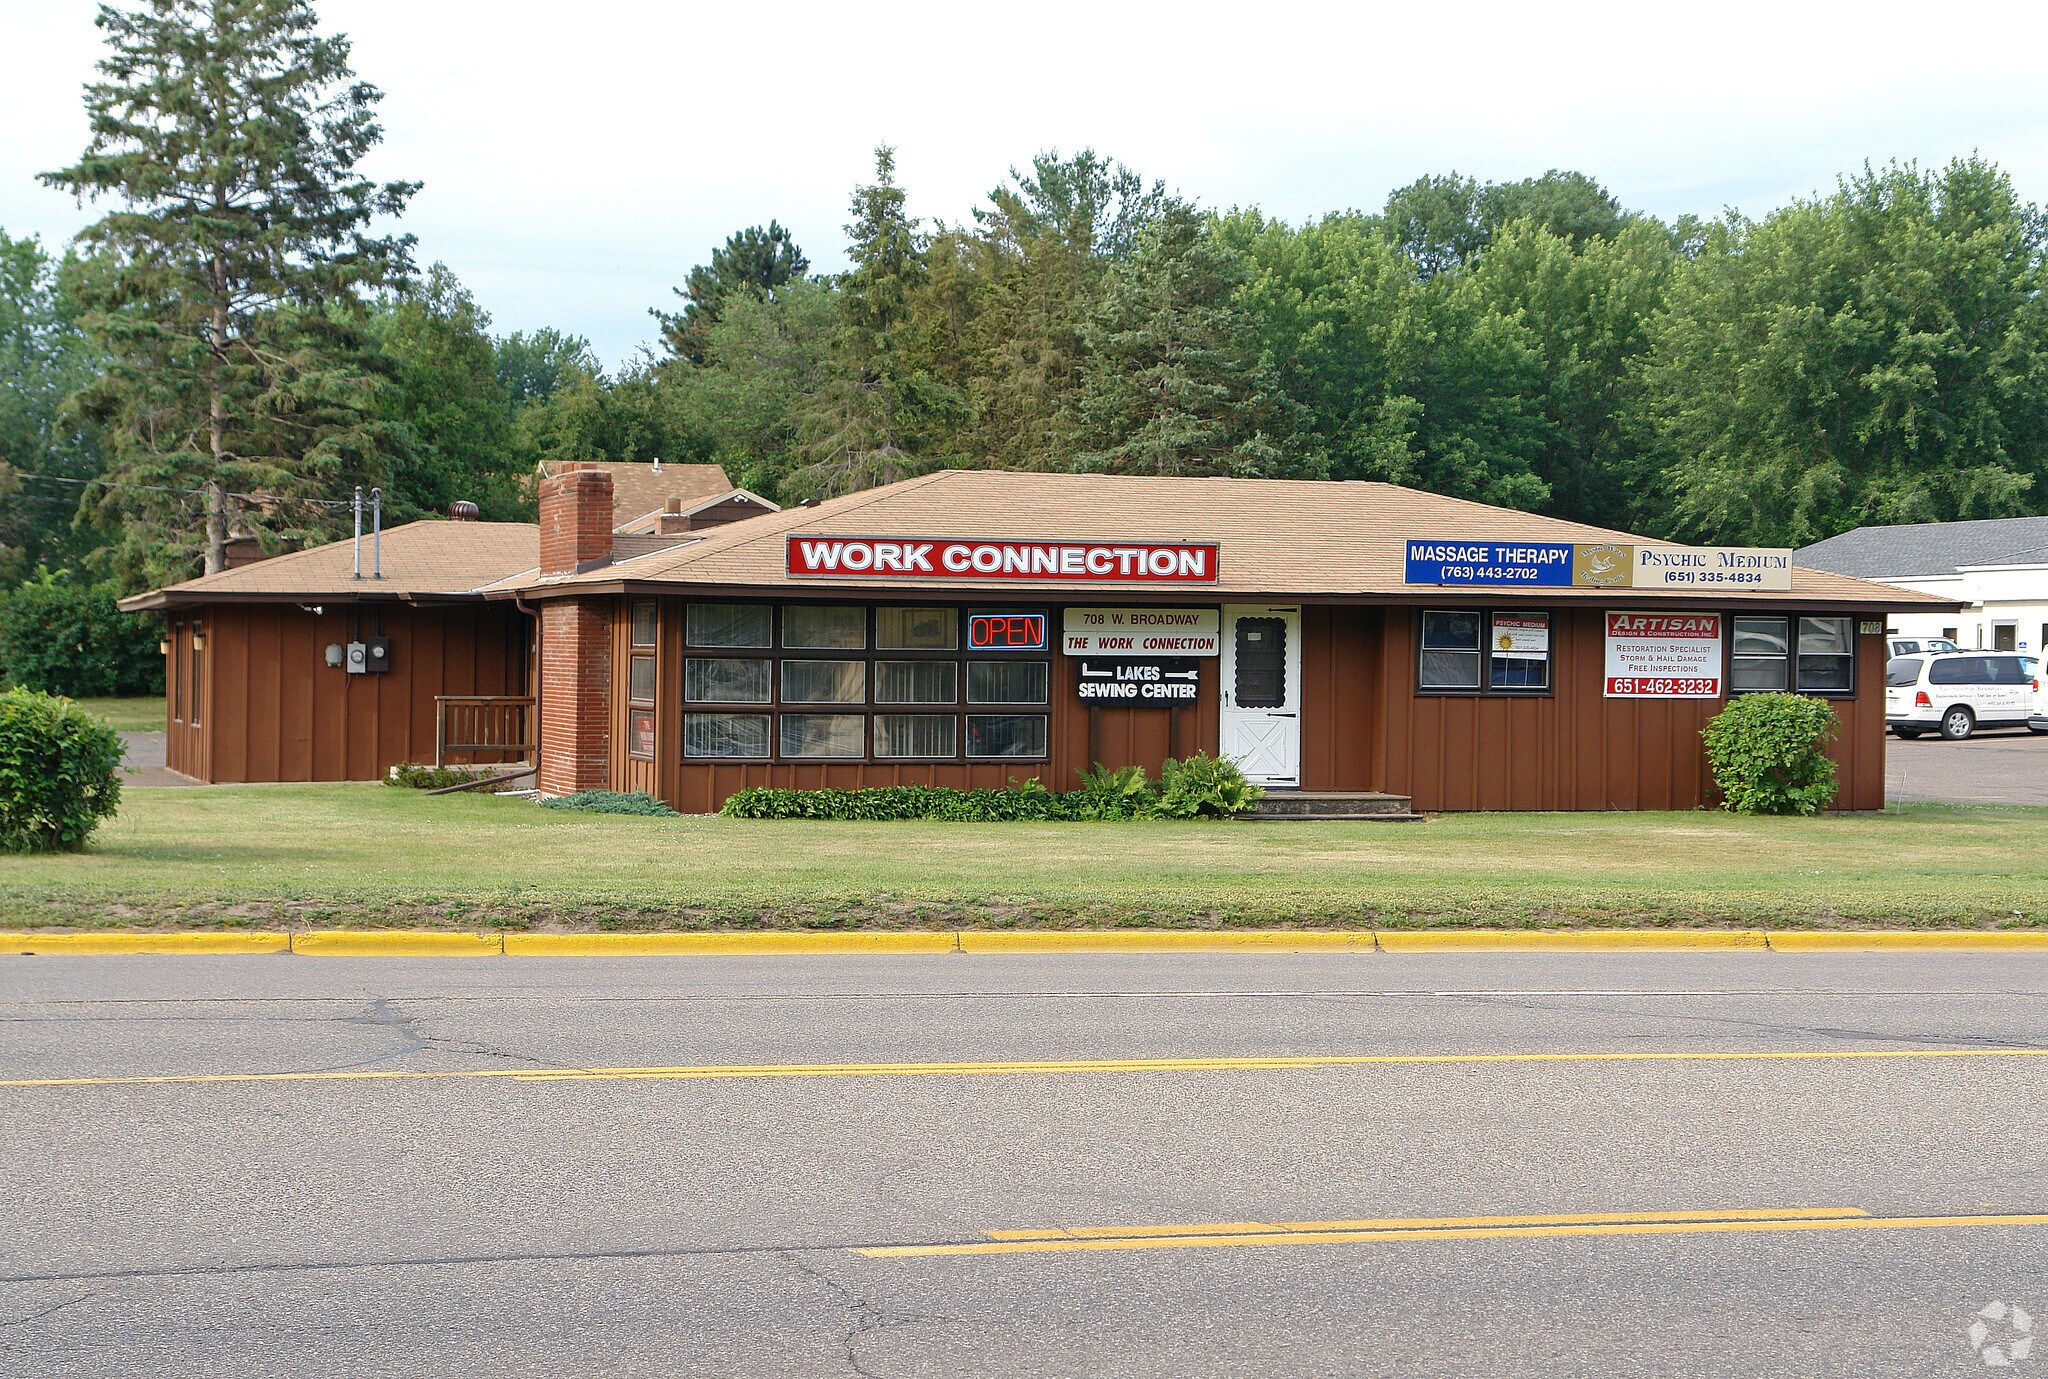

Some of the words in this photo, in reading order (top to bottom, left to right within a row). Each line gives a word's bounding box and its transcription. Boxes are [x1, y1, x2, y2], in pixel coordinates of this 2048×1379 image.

[800, 542, 933, 571] WORK
[942, 545, 1205, 576] CONNECTION
[1411, 545, 1489, 563] MASSAGE
[1495, 547, 1569, 565] THERAPY
[1640, 550, 1707, 567] PSYCHIC
[1717, 551, 1787, 569] MEDIUM
[1440, 566, 1474, 580] (763)
[1476, 567, 1538, 579] 443-2702
[1605, 572, 1627, 584] Center
[1664, 571, 1695, 583] (651)
[1699, 572, 1762, 583] 335-4834
[1083, 614, 1105, 625] 708
[1112, 614, 1125, 625] W.
[1130, 614, 1200, 625] BROADWAY
[1613, 615, 1714, 631] ARTISAN
[971, 617, 1042, 645] OPEN
[1068, 637, 1088, 649] THE
[1098, 637, 1134, 649] WORK
[1143, 637, 1215, 650] CONNECTION
[1616, 644, 1667, 653] RESTORATION
[1669, 645, 1711, 653] SPECIALIST
[1677, 655, 1707, 663] DAMAGE
[1116, 666, 1161, 681] LAKES
[1628, 664, 1648, 672] FREE
[1650, 664, 1698, 673] INSPECTIONS
[1078, 683, 1138, 698] SEWING
[1141, 683, 1197, 698] CENTER
[1614, 679, 1713, 694] 651-462-3232
